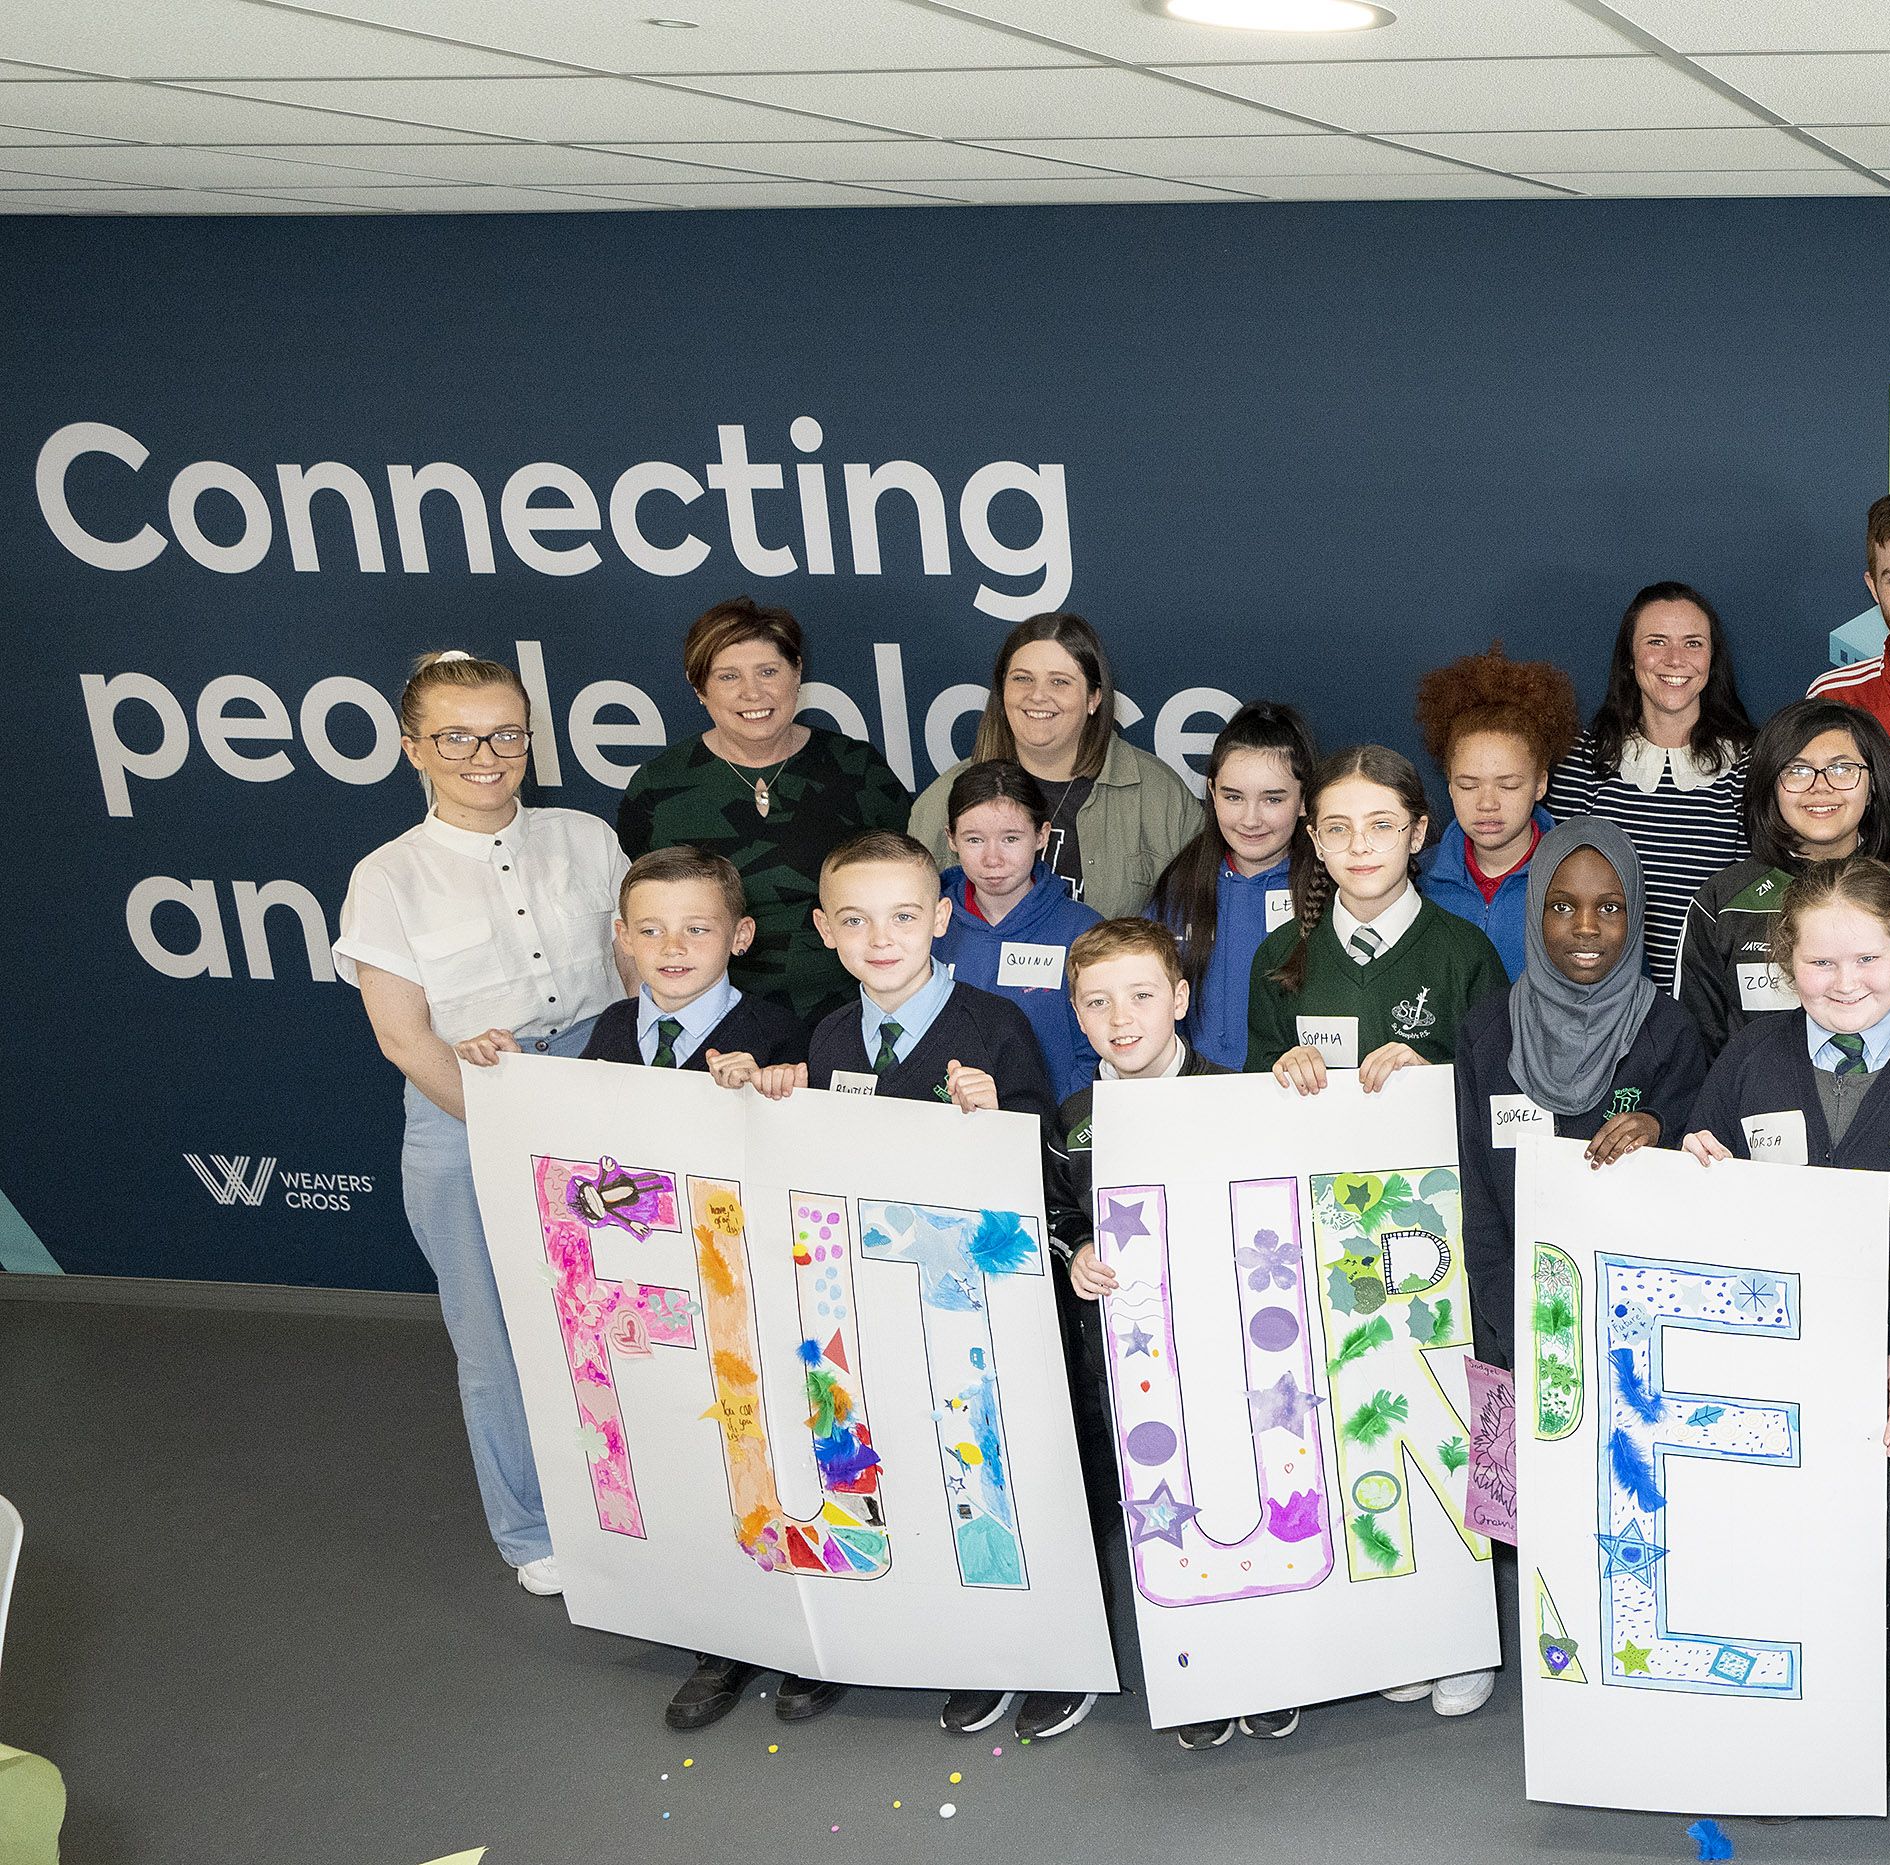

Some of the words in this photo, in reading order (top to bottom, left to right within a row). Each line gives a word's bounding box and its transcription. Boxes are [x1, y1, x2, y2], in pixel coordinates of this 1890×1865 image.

[35, 416, 1073, 621] Connecting
[80, 640, 667, 818] peole
[1756, 879, 1775, 897] ZM
[1006, 953, 1054, 967] QUINN
[1744, 976, 1780, 990] ZOE
[1301, 1030, 1343, 1046] SOPHIA
[1496, 1109, 1543, 1126] SODGEL
[279, 1171, 373, 1193] WEAVERS
[285, 1192, 351, 1212] CROSS
